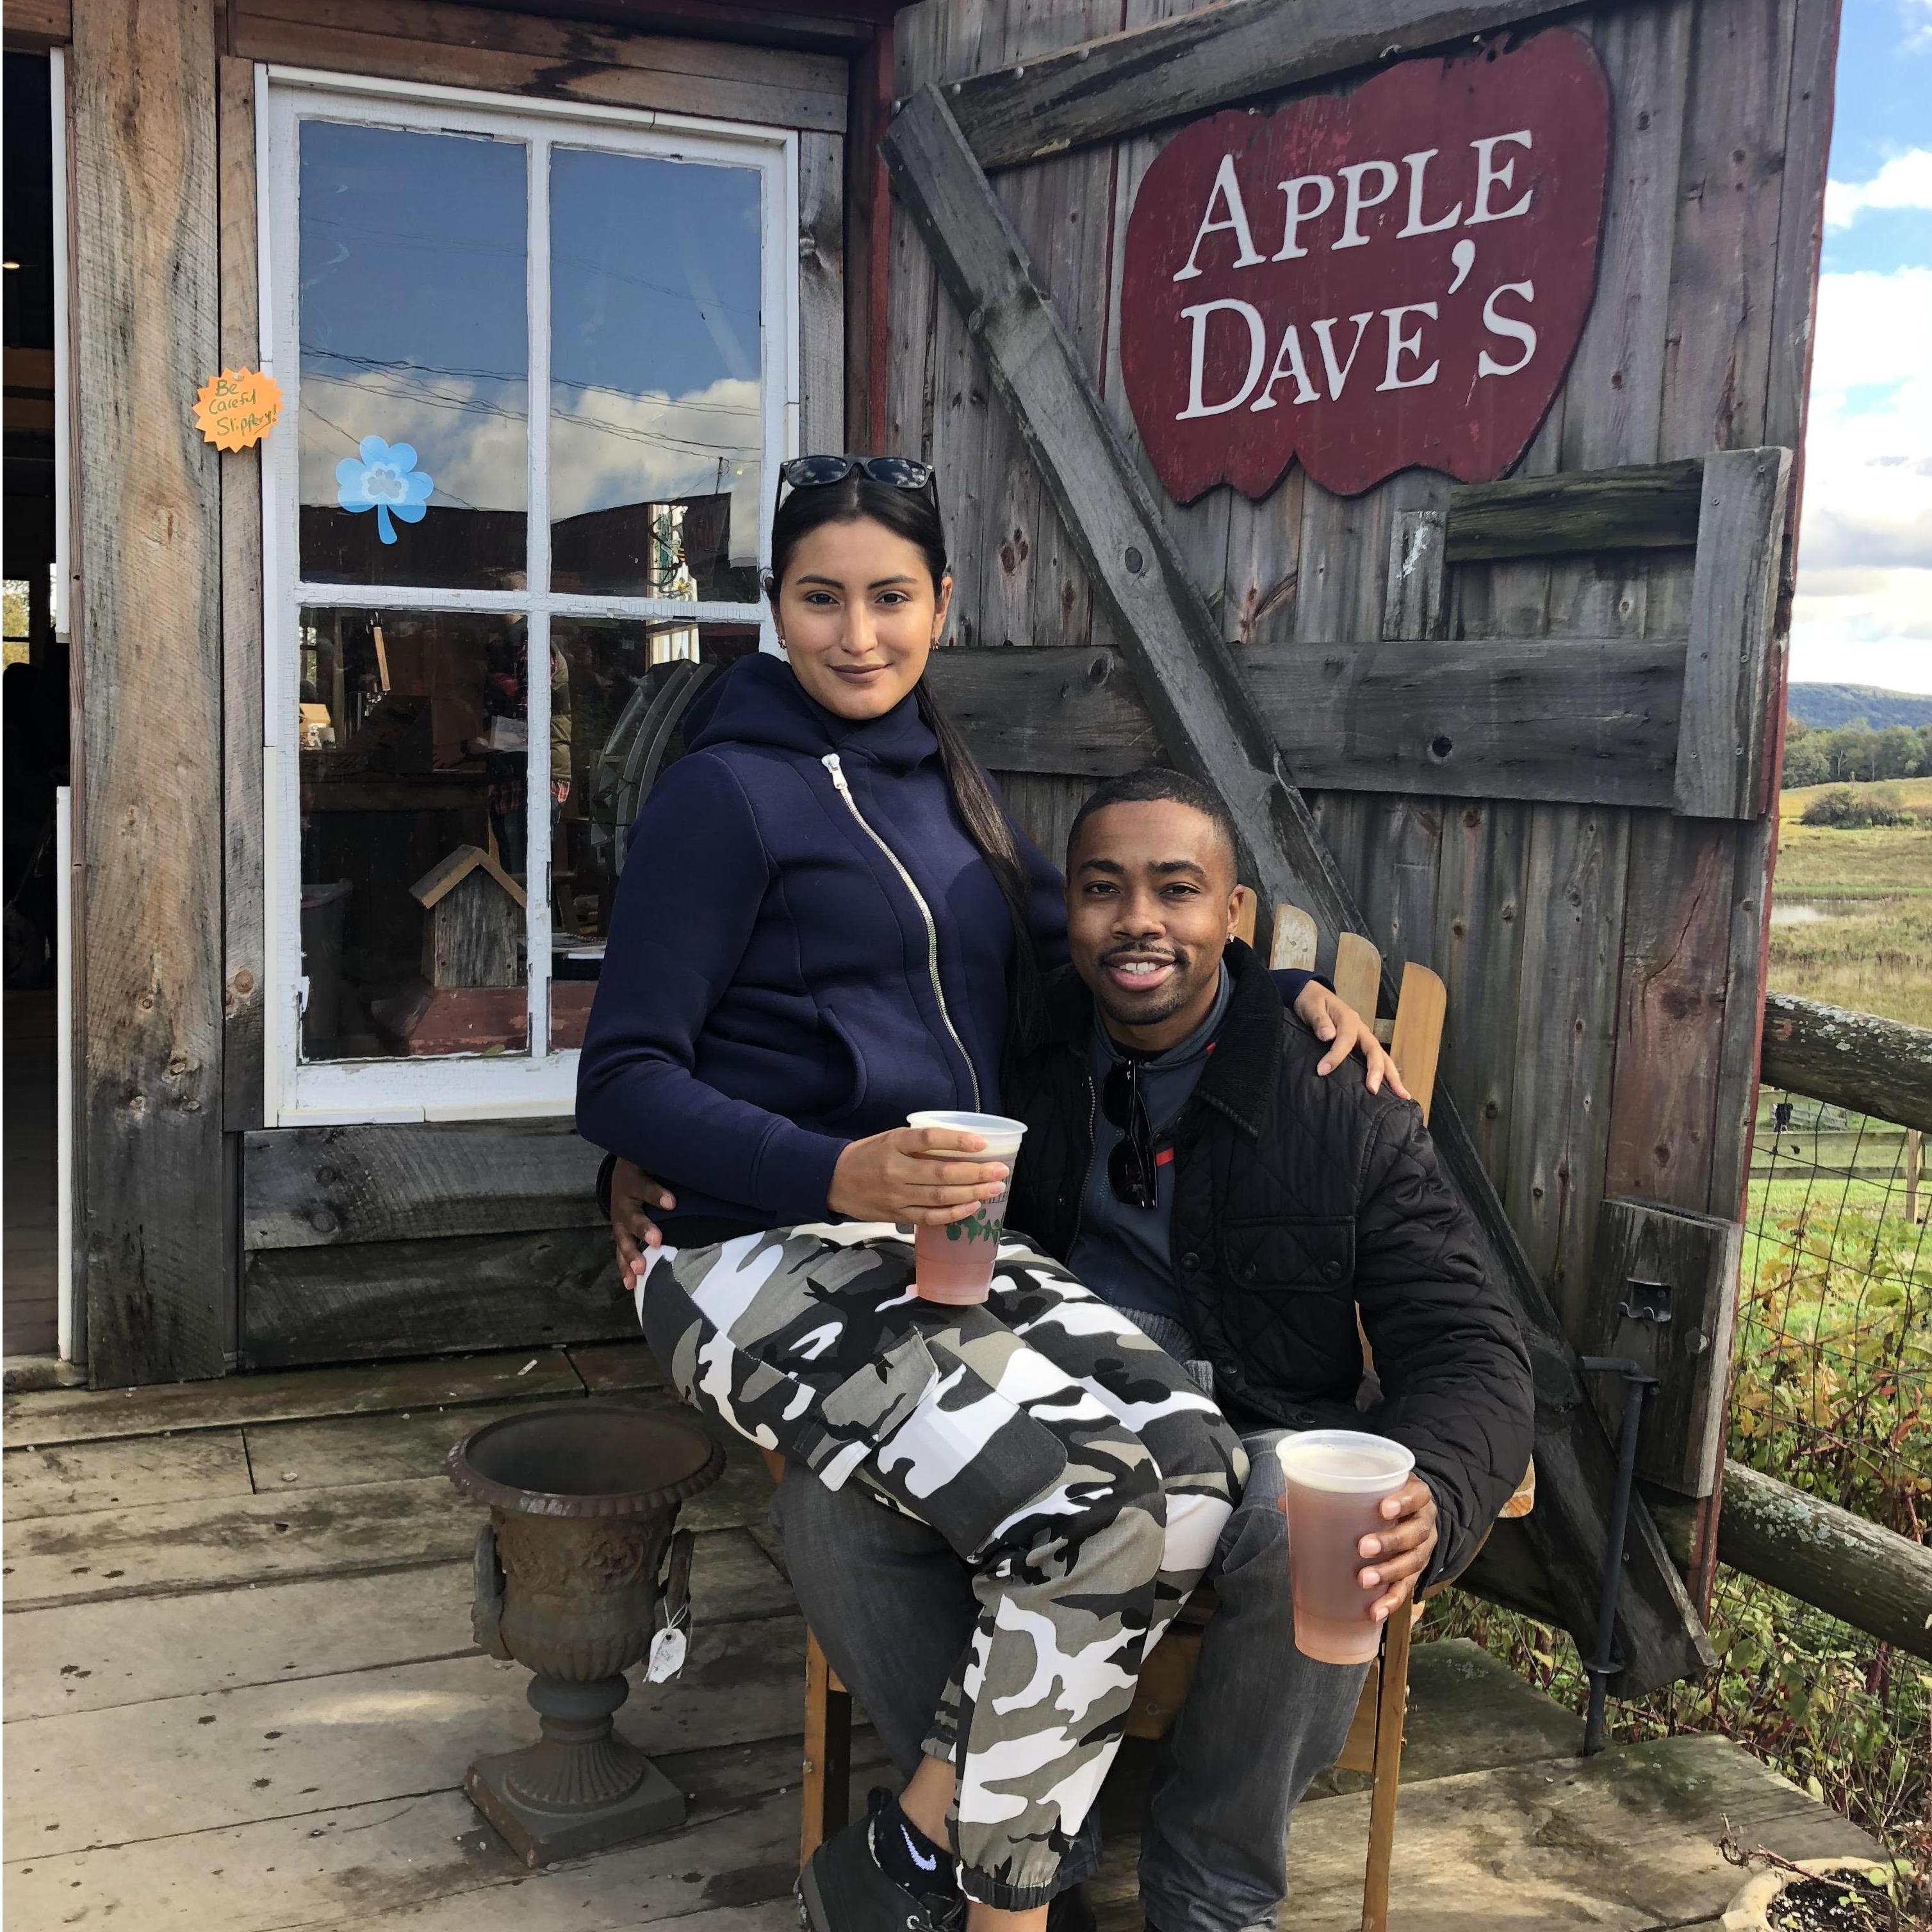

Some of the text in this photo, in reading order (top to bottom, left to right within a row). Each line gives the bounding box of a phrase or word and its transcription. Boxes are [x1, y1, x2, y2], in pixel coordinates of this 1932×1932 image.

[1173, 129, 1533, 282] APPLE
[1175, 239, 1537, 421] DAVE'S
[209, 388, 256, 415] Careful
[215, 379, 240, 397] Be
